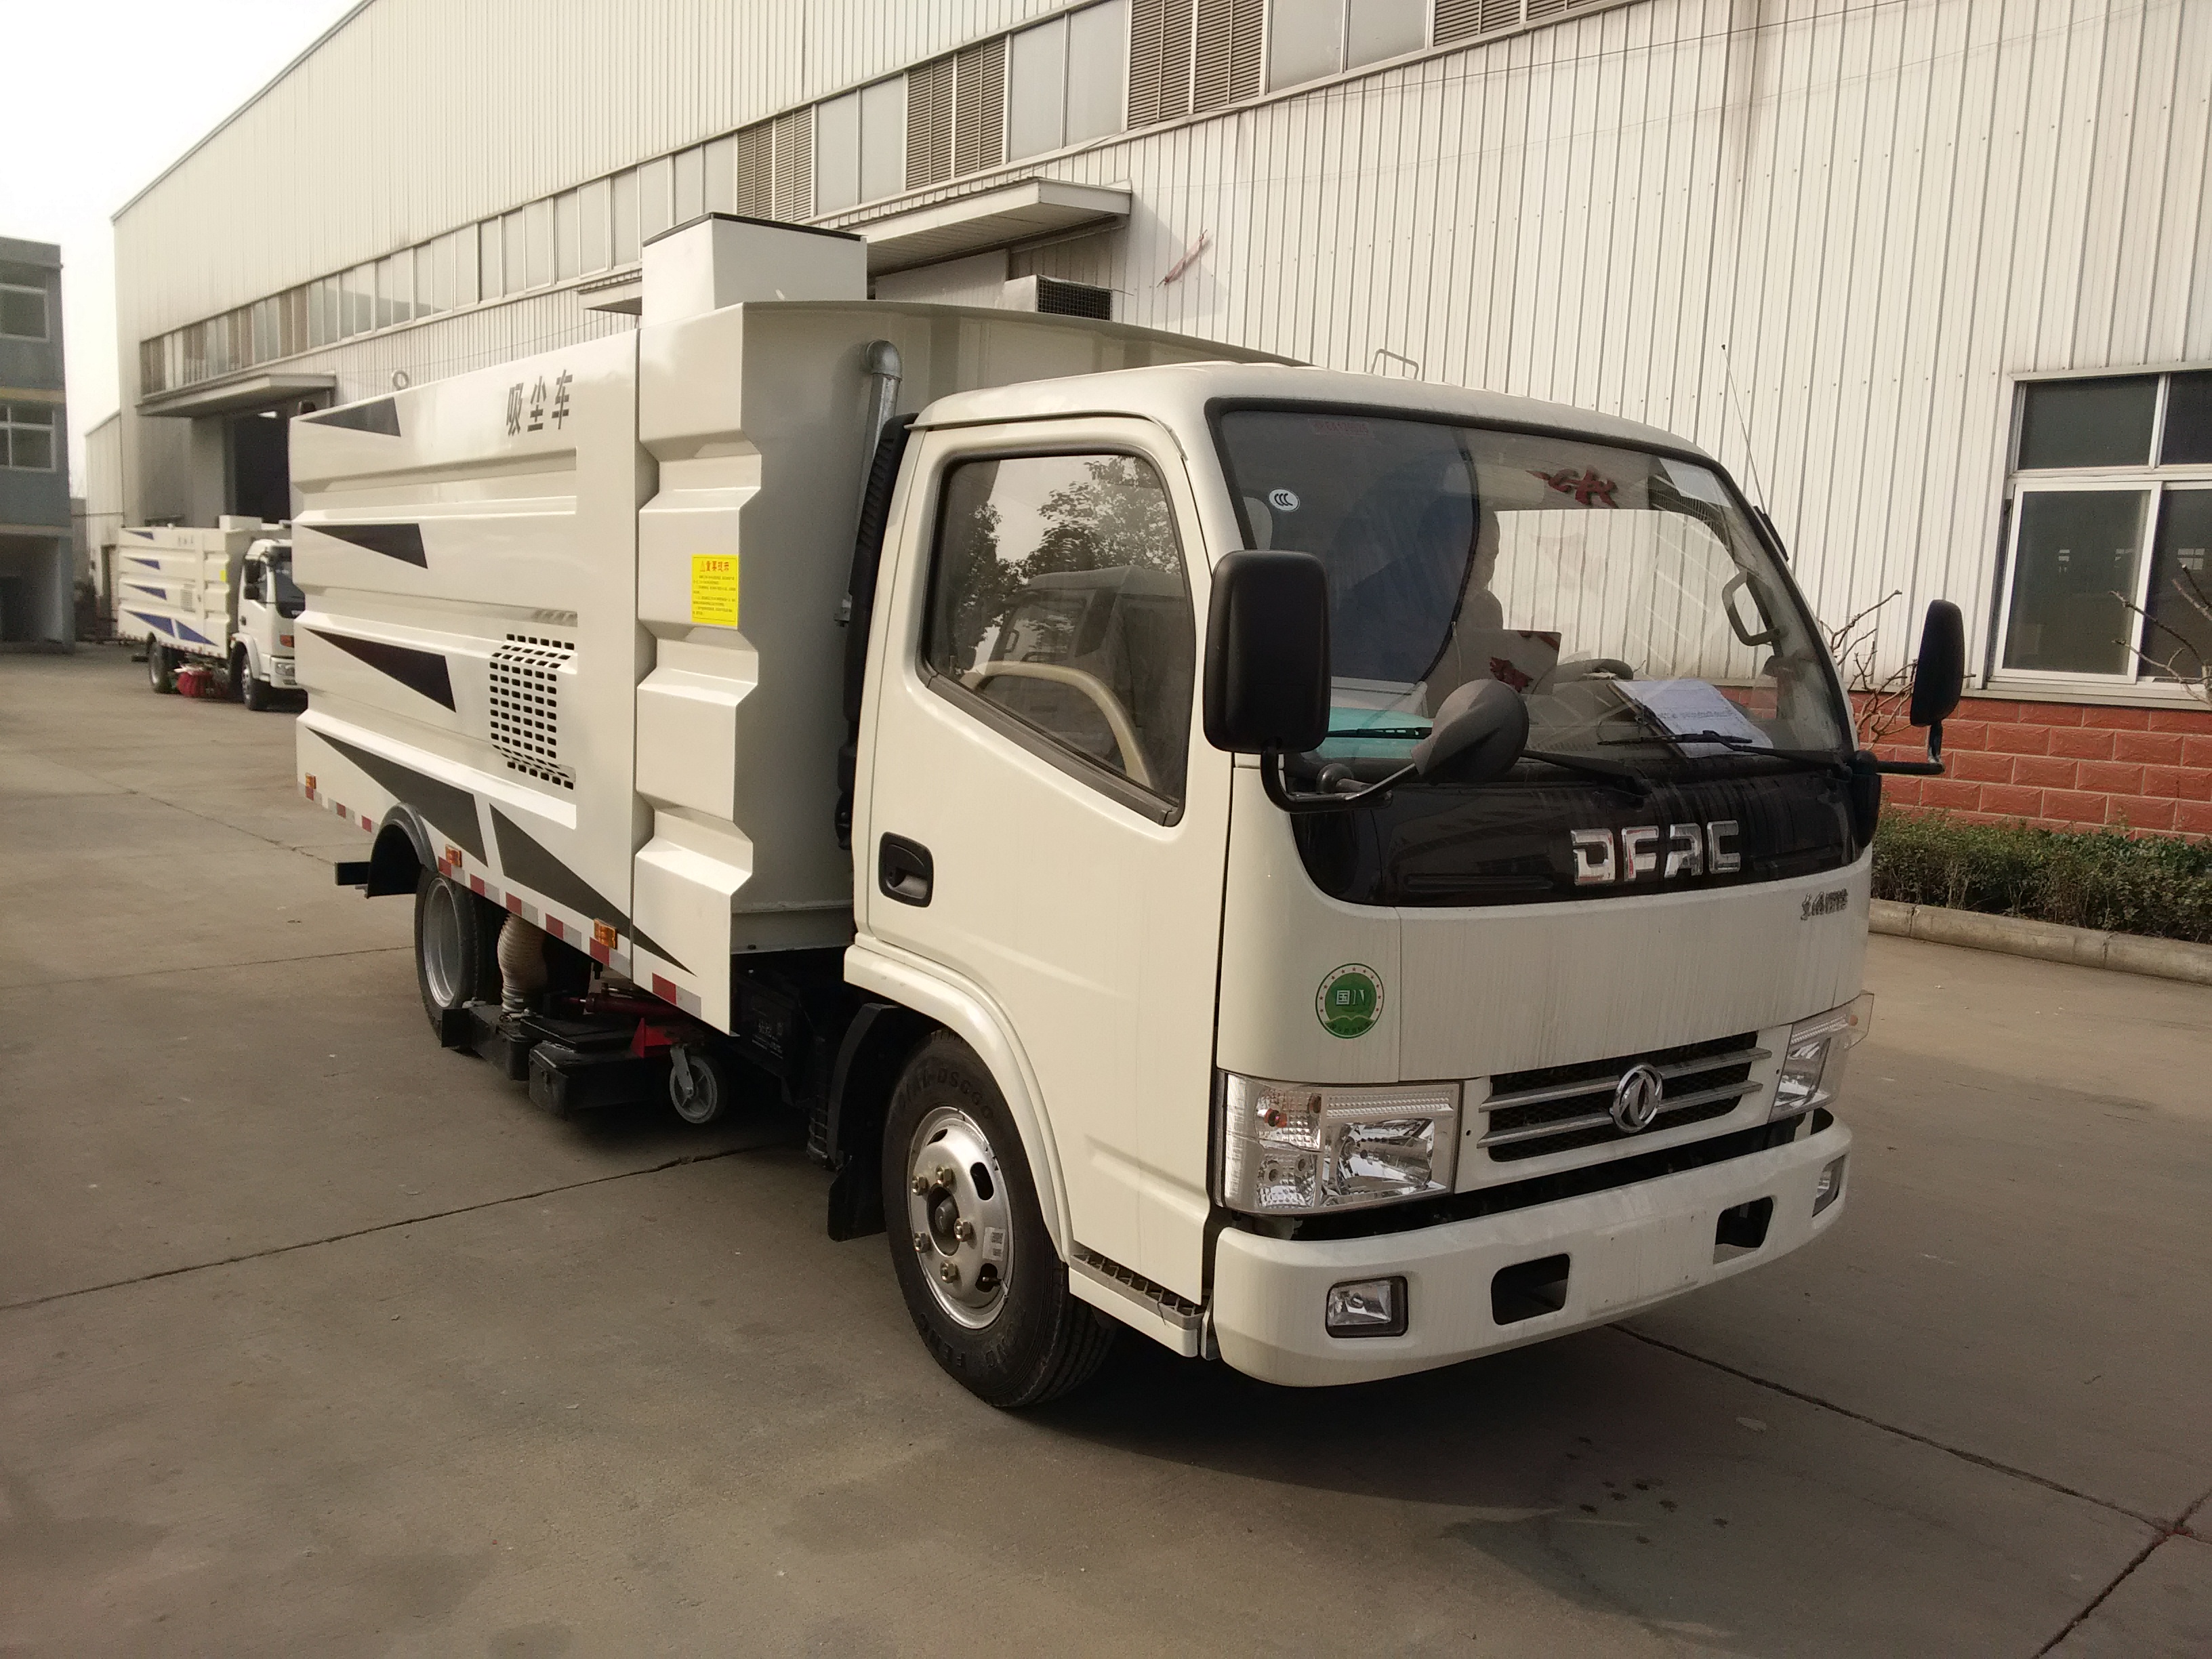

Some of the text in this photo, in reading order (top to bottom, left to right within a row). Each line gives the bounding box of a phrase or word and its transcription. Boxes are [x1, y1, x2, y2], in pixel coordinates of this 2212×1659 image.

[506, 369, 573, 436] 吸尘车
[1570, 819, 1741, 886] DFAC
